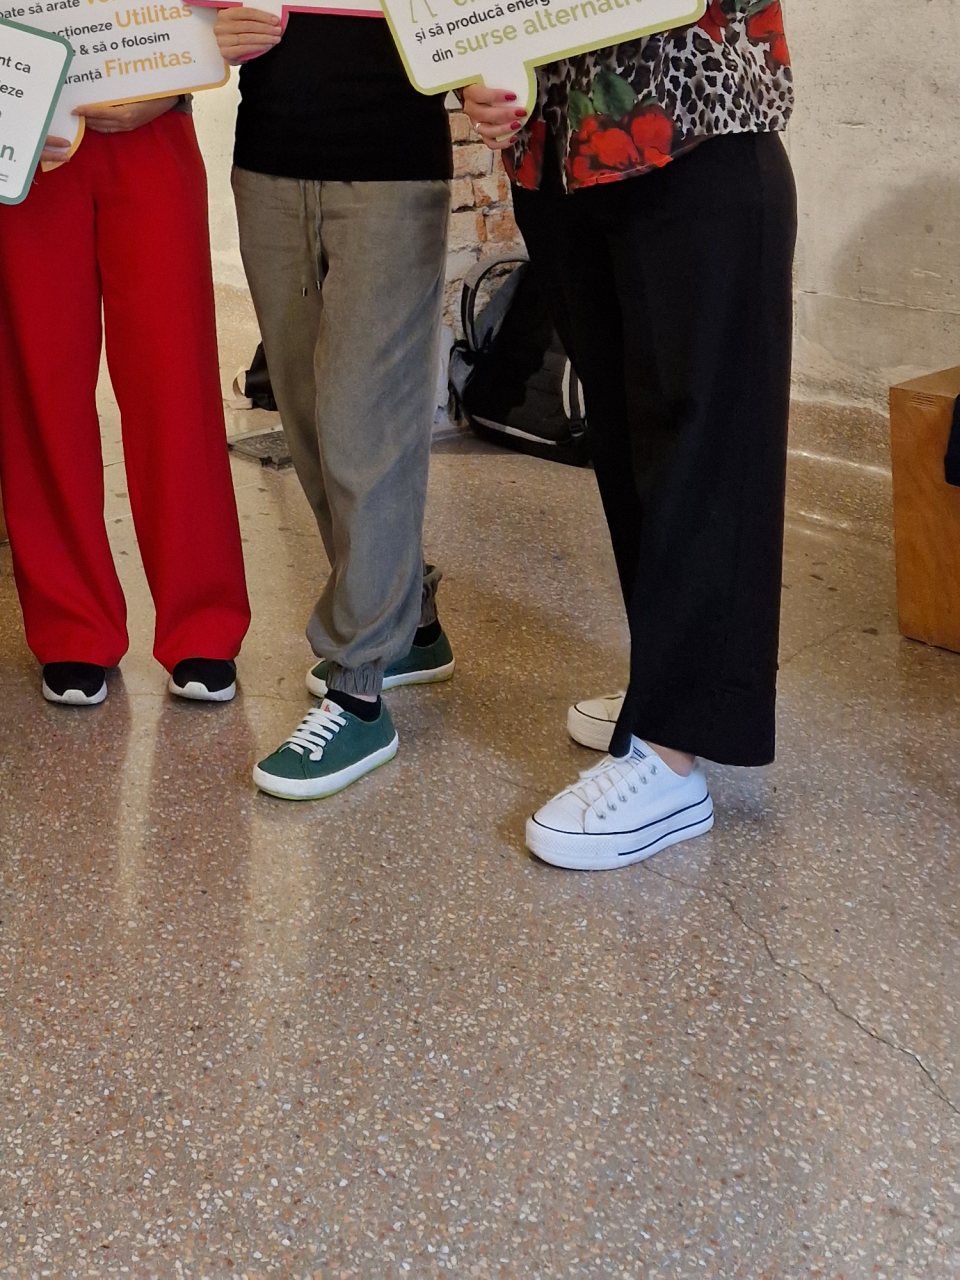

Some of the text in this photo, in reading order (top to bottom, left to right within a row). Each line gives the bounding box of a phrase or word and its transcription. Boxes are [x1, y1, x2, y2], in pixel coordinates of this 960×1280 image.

[28, 2, 44, 15] să
[115, 4, 193, 29] Utilitas
[415, 27, 427, 44] și
[428, 22, 445, 38] să
[445, 3, 505, 36] producă
[92, 41, 108, 54] să
[110, 41, 119, 50] o
[121, 32, 170, 49] folosim
[432, 48, 454, 63] din
[455, 25, 517, 56] surse
[14, 61, 31, 74] ca
[104, 51, 196, 78] Firmitas.
